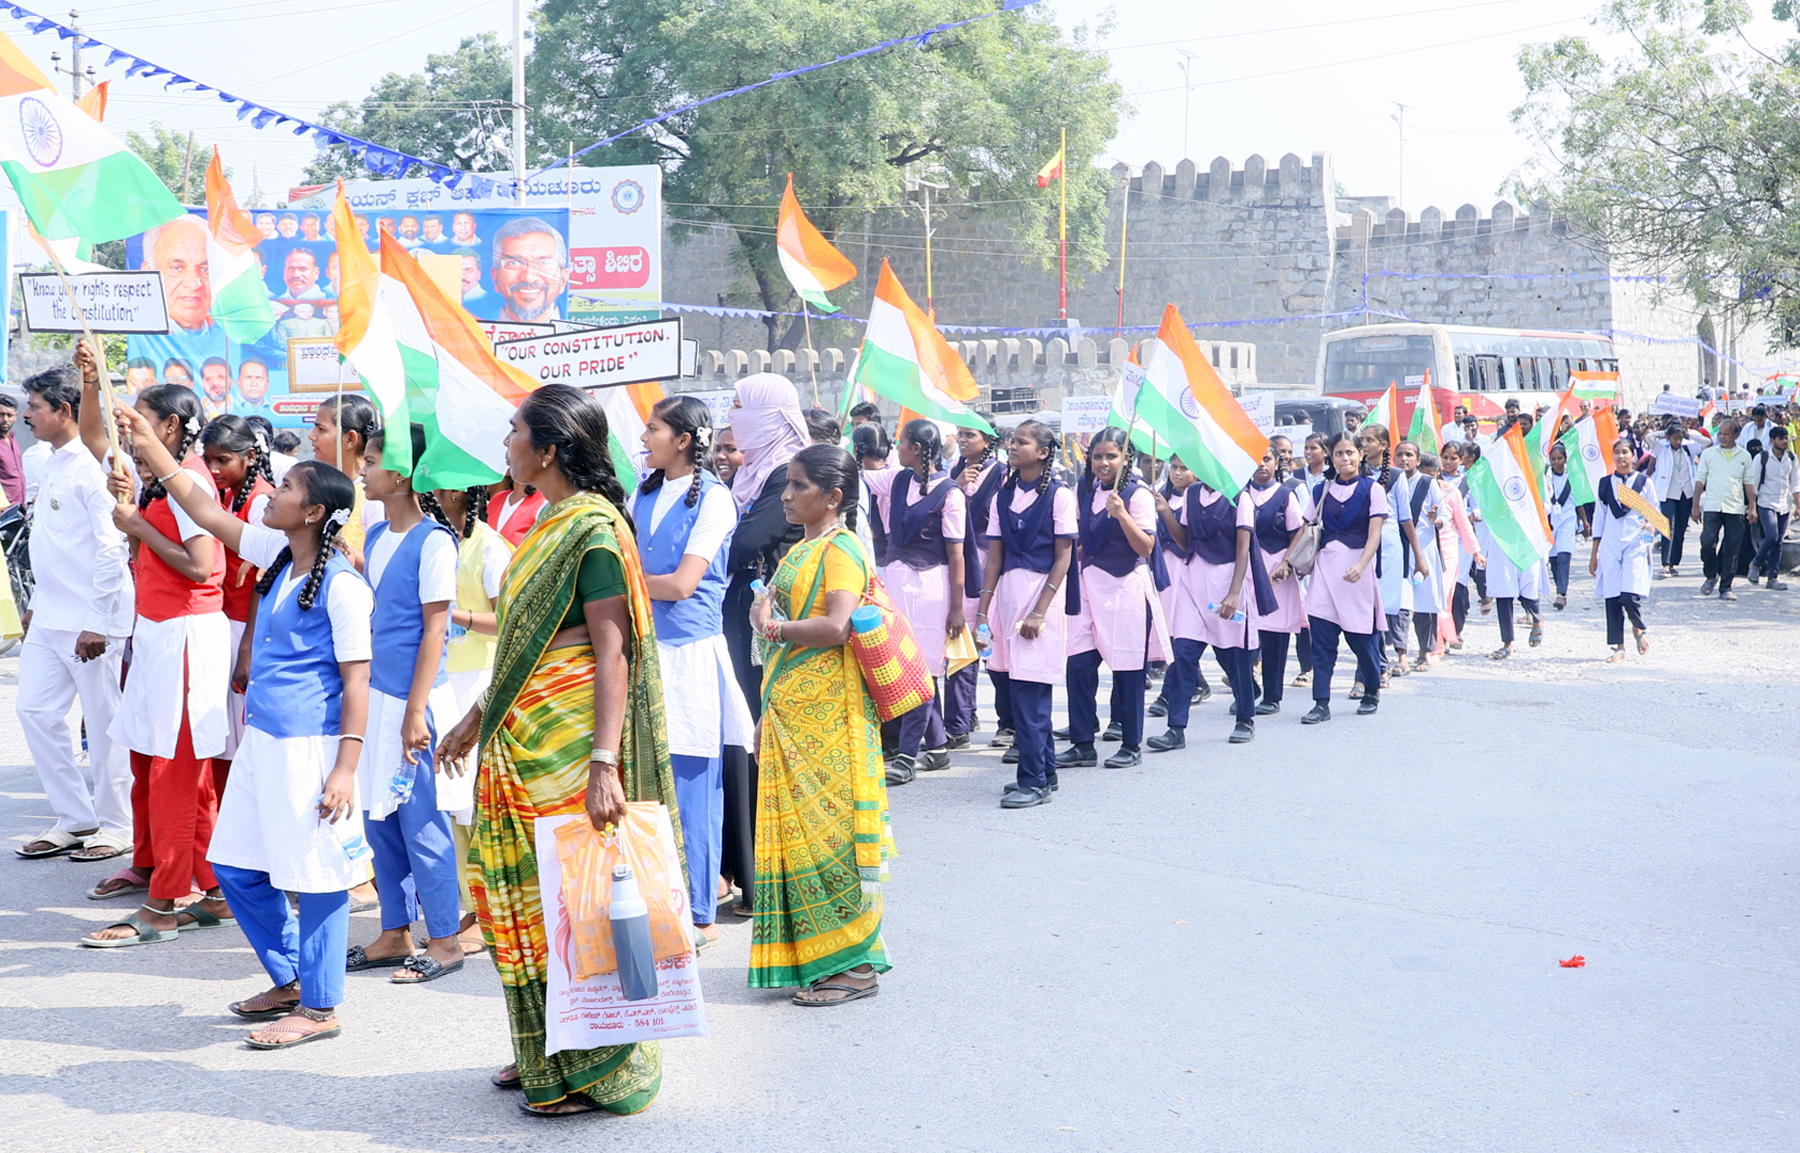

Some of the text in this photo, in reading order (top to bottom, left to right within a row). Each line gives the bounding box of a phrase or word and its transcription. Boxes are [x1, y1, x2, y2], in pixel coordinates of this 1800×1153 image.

[604, 249, 643, 273] ಶಿಬಿರ
[82, 279, 110, 301] rights
[113, 280, 153, 302] respect
[52, 299, 67, 320] the
[540, 364, 572, 379] OUR
[635, 1019, 650, 1027] 584
